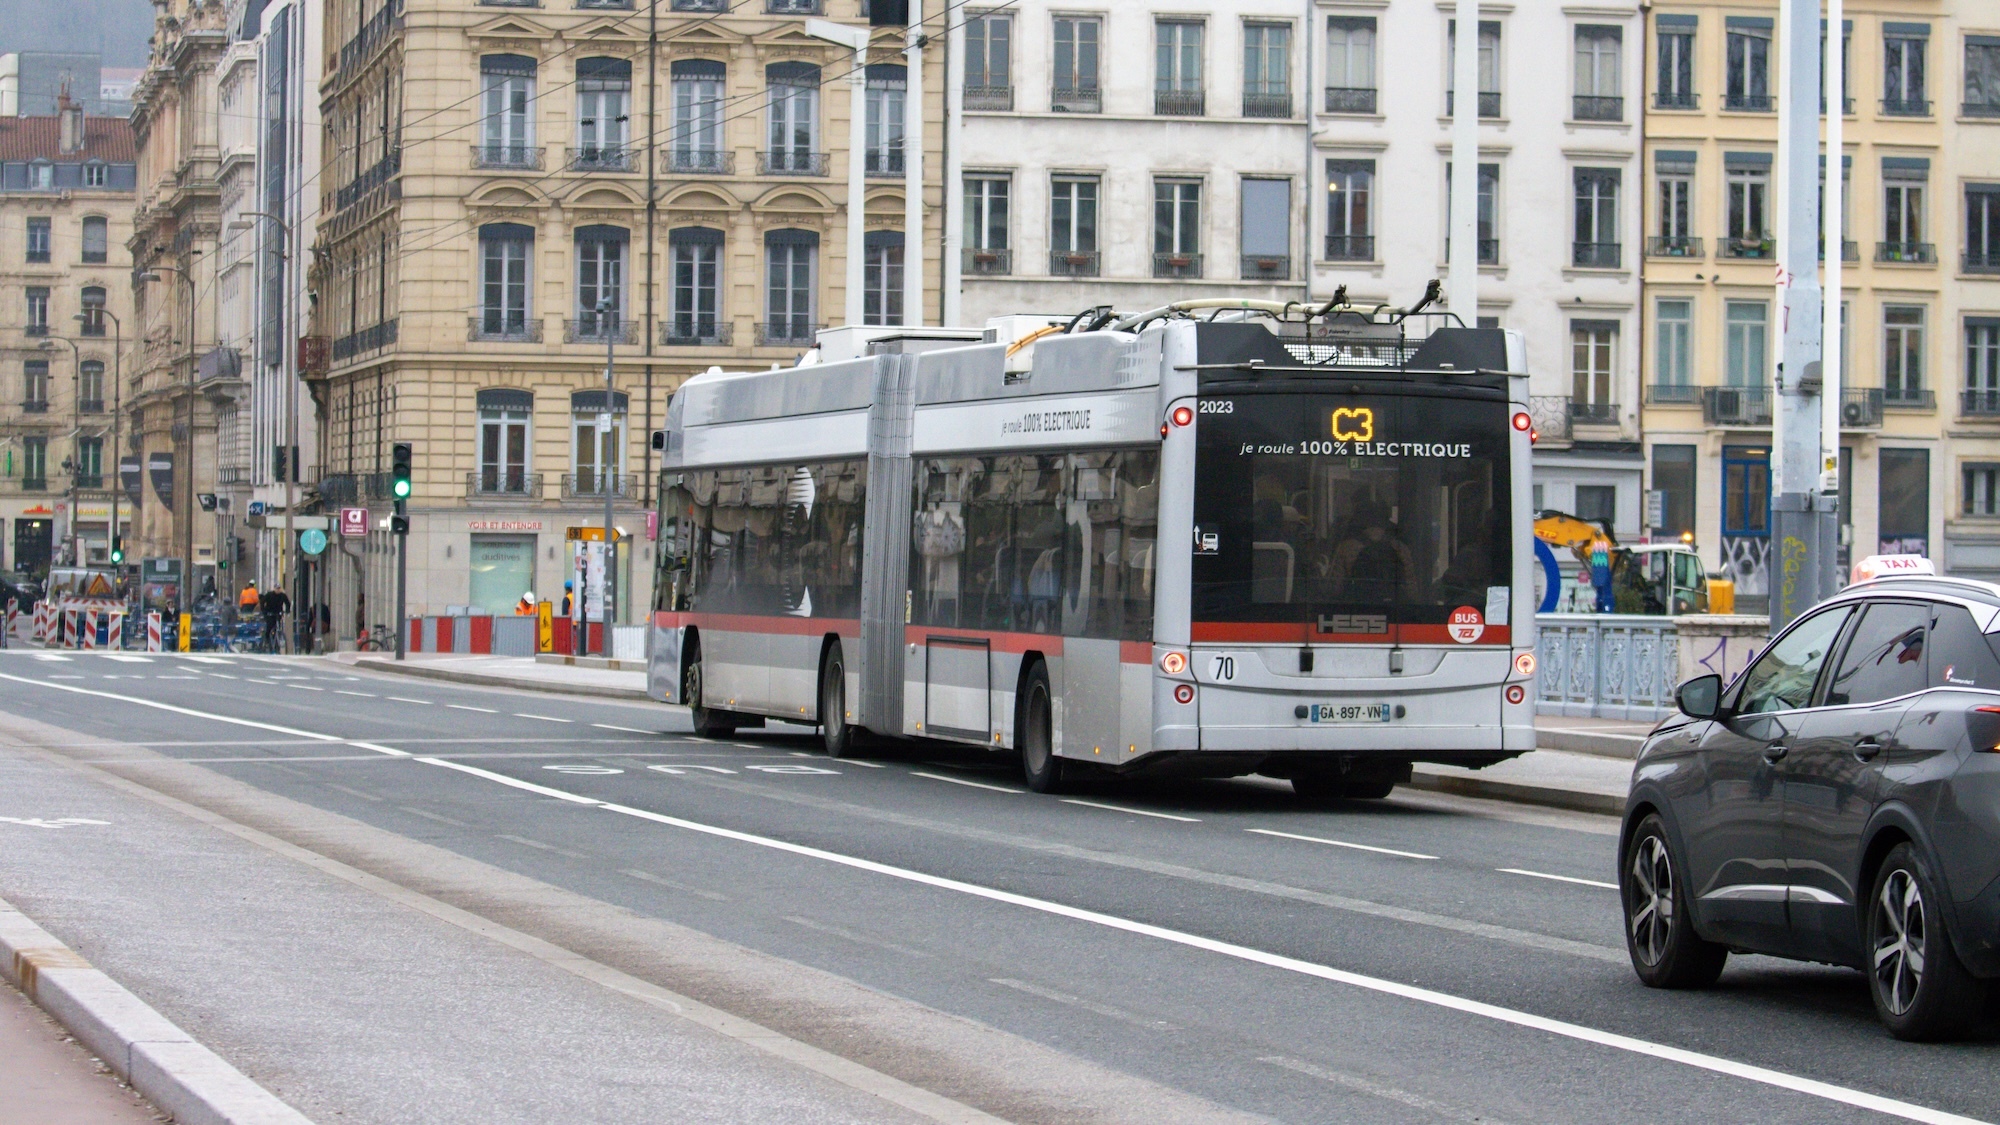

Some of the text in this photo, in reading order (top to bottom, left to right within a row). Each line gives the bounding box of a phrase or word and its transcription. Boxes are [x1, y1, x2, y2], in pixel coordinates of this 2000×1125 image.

[1199, 400, 1234, 414] 2023
[1023, 413, 1042, 433] 100%
[1044, 409, 1091, 431] ELECTRIQUE
[1332, 407, 1373, 442] C3
[1239, 440, 1471, 458] je roule 100% ELECTRIQUE
[468, 521, 542, 530] VOIR ET ENTENDRE
[481, 552, 520, 561] auditives
[1880, 559, 1918, 569] TAXI
[1318, 614, 1387, 633] HESS
[1454, 613, 1478, 624] BUS
[1457, 628, 1475, 638] TCL
[1216, 656, 1234, 680] 70
[1320, 706, 1381, 719] GA-897-VN
